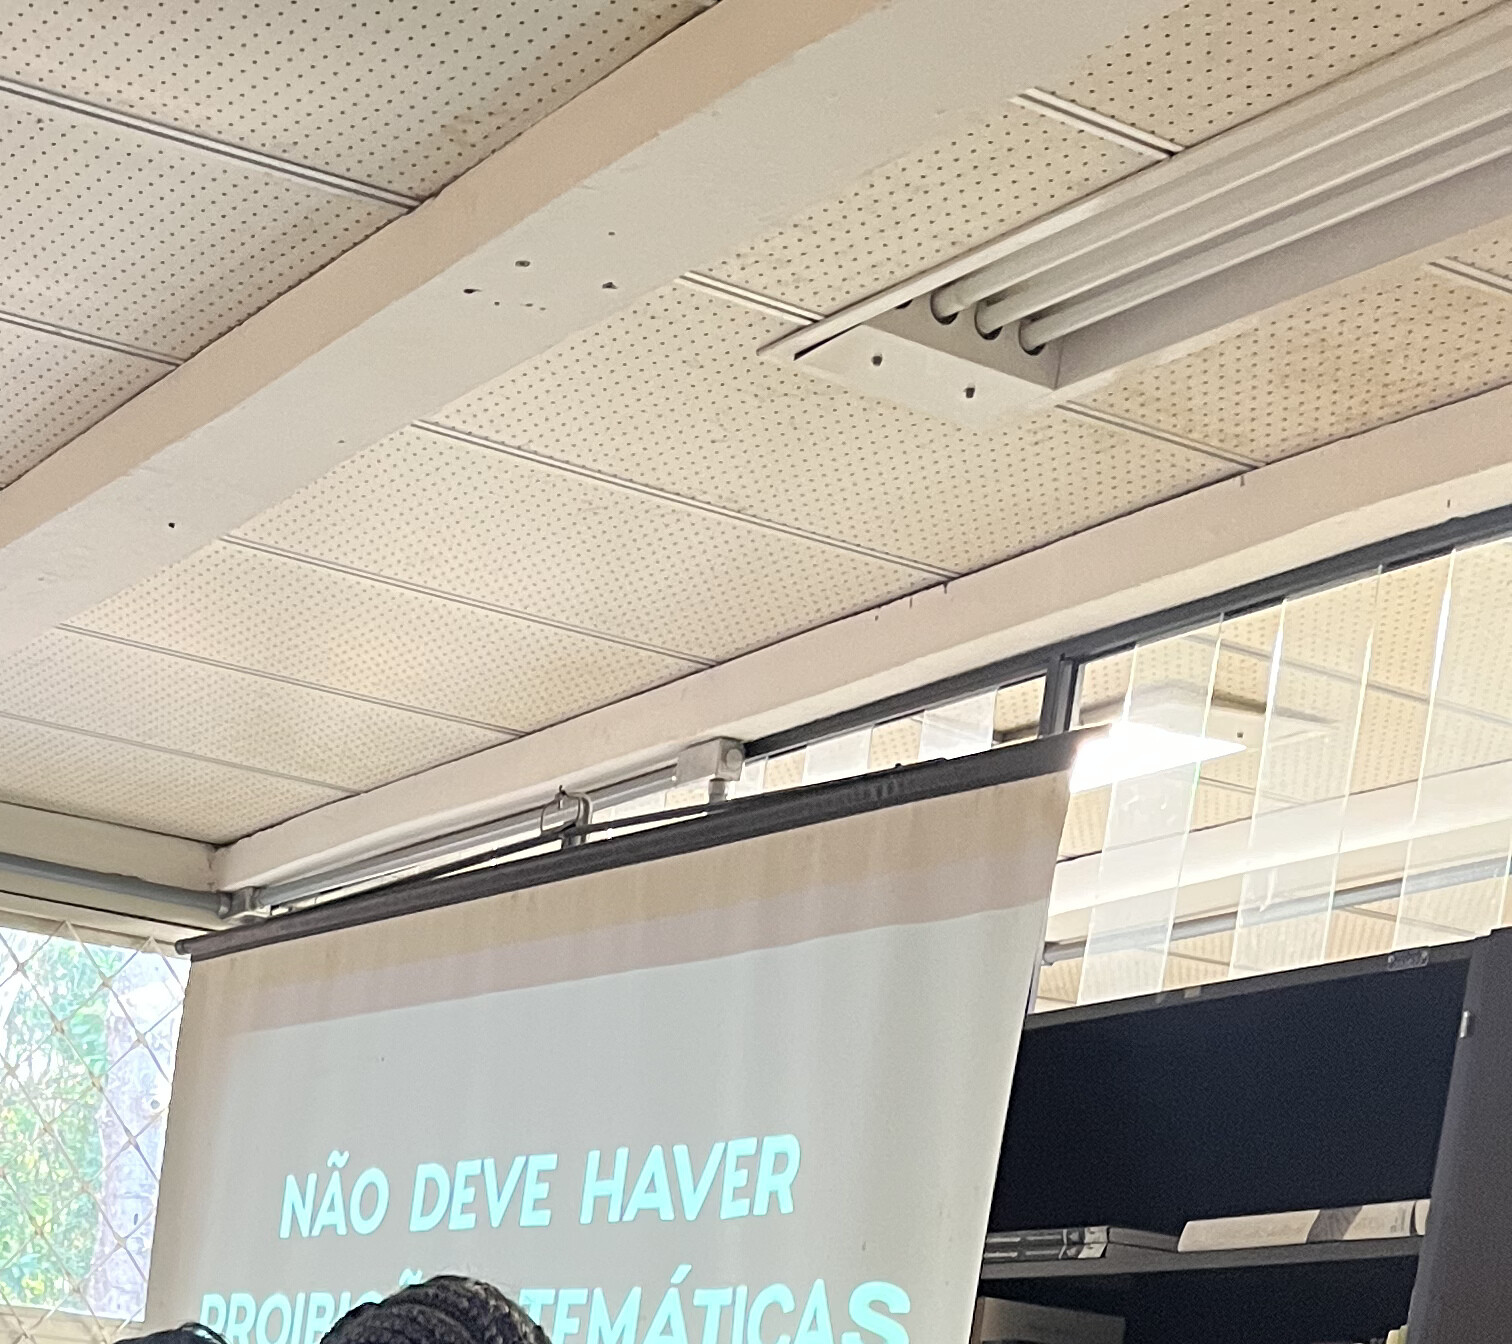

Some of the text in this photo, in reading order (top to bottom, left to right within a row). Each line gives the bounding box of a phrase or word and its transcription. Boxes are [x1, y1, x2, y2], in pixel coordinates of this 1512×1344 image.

[280, 1134, 800, 1238] NÃO DEVE HAVER
